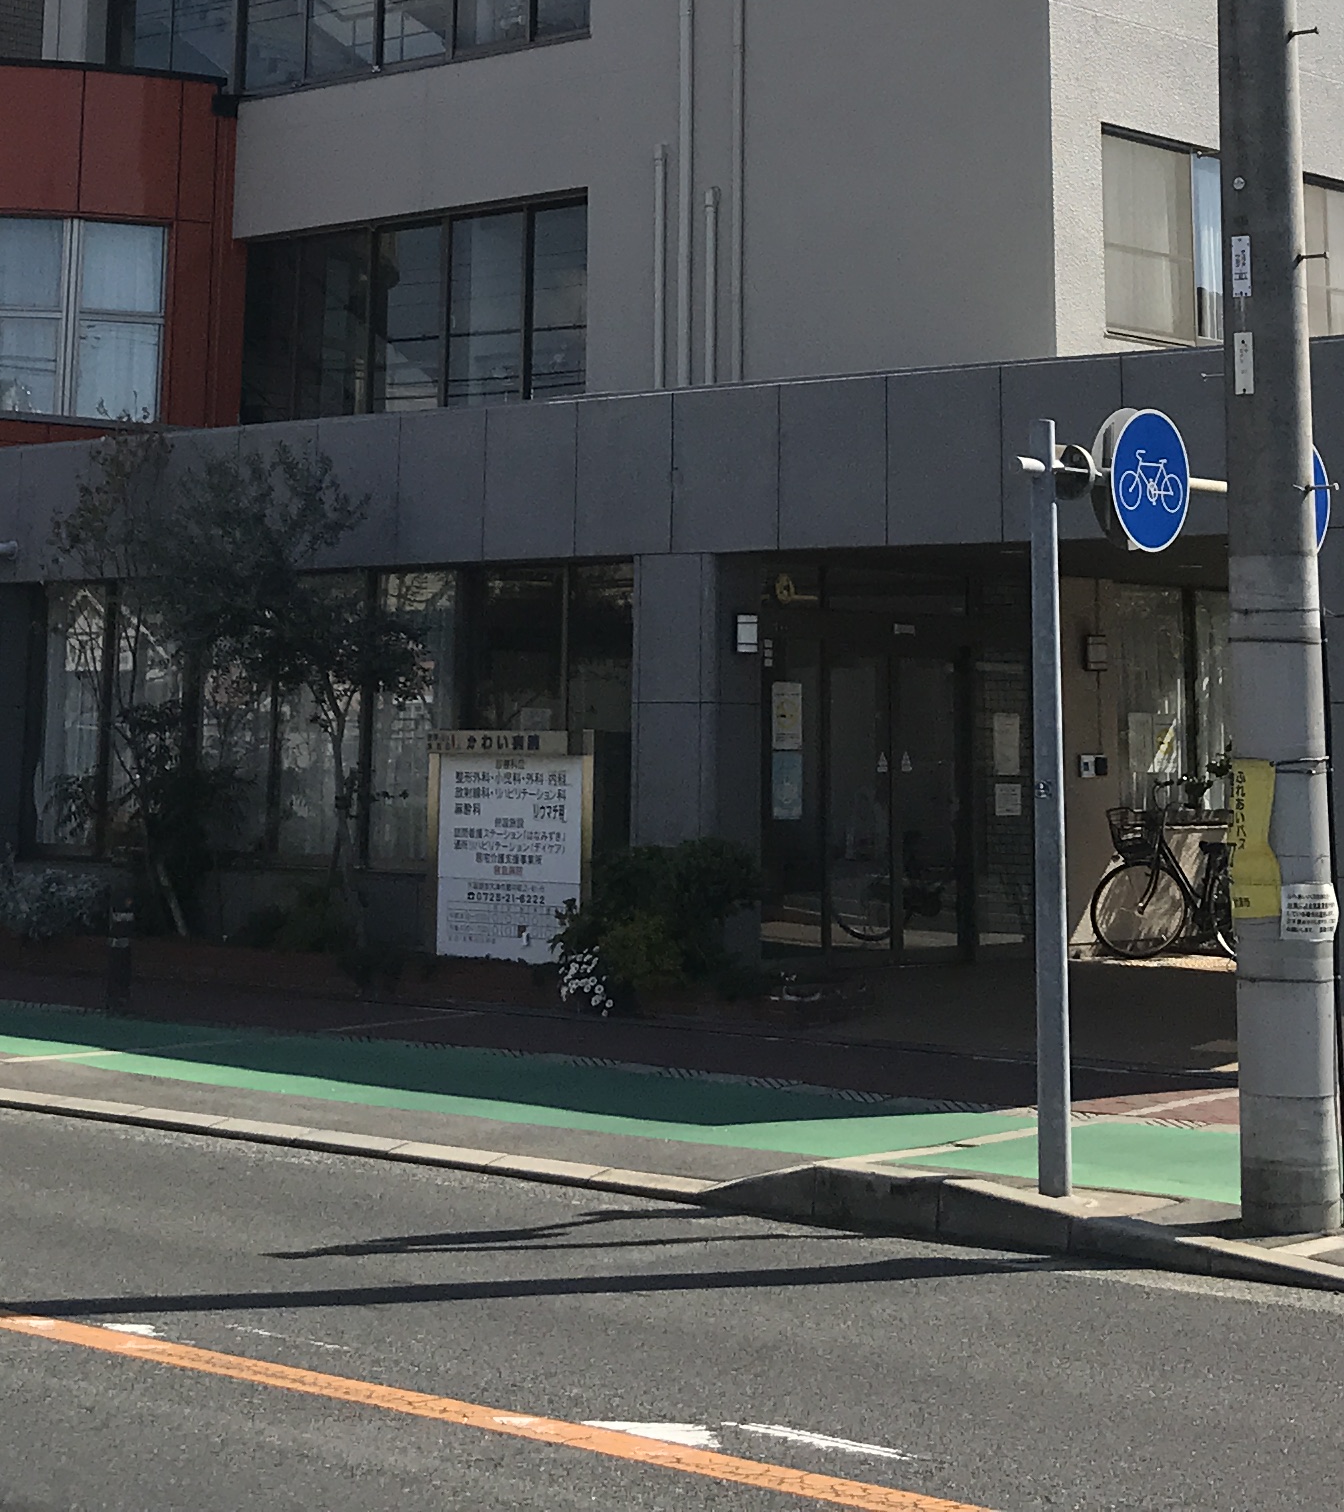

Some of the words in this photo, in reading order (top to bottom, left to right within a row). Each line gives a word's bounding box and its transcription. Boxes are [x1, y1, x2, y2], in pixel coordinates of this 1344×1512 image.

[466, 734, 540, 751] かわい病院
